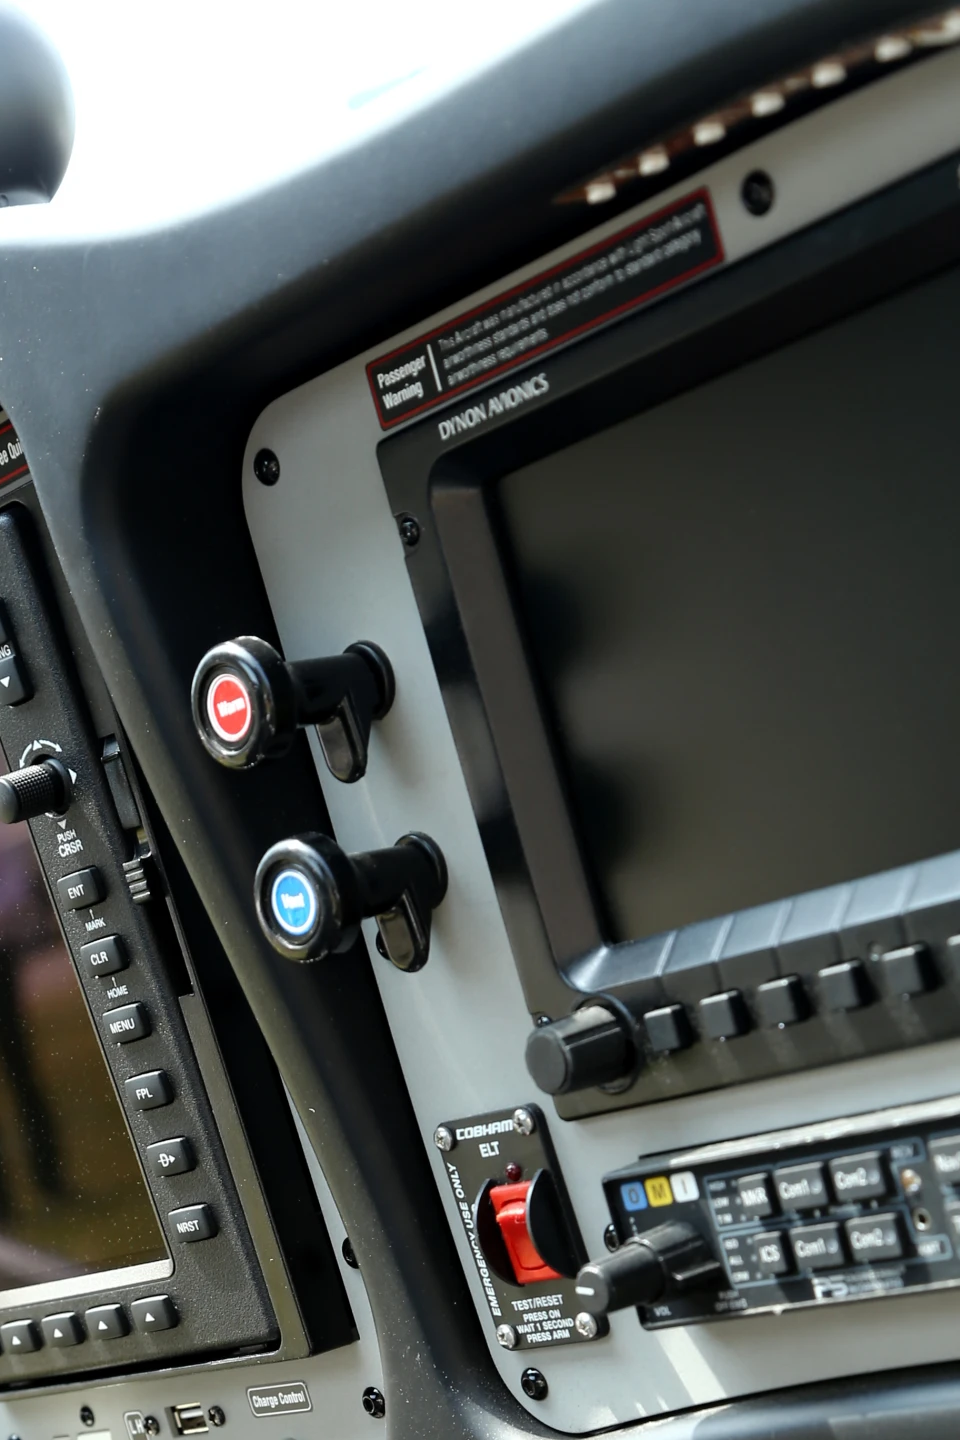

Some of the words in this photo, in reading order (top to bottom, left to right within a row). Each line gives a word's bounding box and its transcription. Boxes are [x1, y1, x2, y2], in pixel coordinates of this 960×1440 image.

[377, 355, 426, 389] Passenger
[382, 381, 424, 409] Warning
[438, 403, 487, 441] DYNON
[488, 372, 550, 417] AVIONICS
[57, 829, 76, 843] PUSH
[58, 839, 83, 858] CRSR
[67, 885, 85, 899] ENT
[85, 918, 106, 931] MARK
[90, 952, 108, 966] CLR
[106, 985, 128, 999] HOME
[109, 1018, 136, 1034] MENU
[135, 1087, 153, 1101] FPL
[456, 1119, 513, 1141] COBHAM
[479, 1141, 500, 1158] ELT
[446, 1162, 465, 1199] ONLY
[741, 1186, 768, 1207] MKR
[779, 1179, 810, 1200] Com1
[834, 1166, 868, 1190] Com2
[651, 1183, 667, 1200] M
[459, 1202, 474, 1229] USE
[176, 1219, 200, 1234] NRST
[760, 1244, 780, 1263] ICS
[794, 1237, 827, 1257] Com1
[850, 1228, 884, 1250] Com2
[511, 1294, 563, 1311] TEST/RESET
[523, 1310, 548, 1322] PRESS
[549, 1309, 561, 1318] ON
[516, 1322, 535, 1334] WAIT
[542, 1317, 574, 1331] SECOND
[526, 1331, 552, 1343] PRESS
[553, 1329, 570, 1340] ARM
[252, 1394, 279, 1408] Charge
[278, 1390, 306, 1405] Control
[129, 1419, 145, 1434] LH
